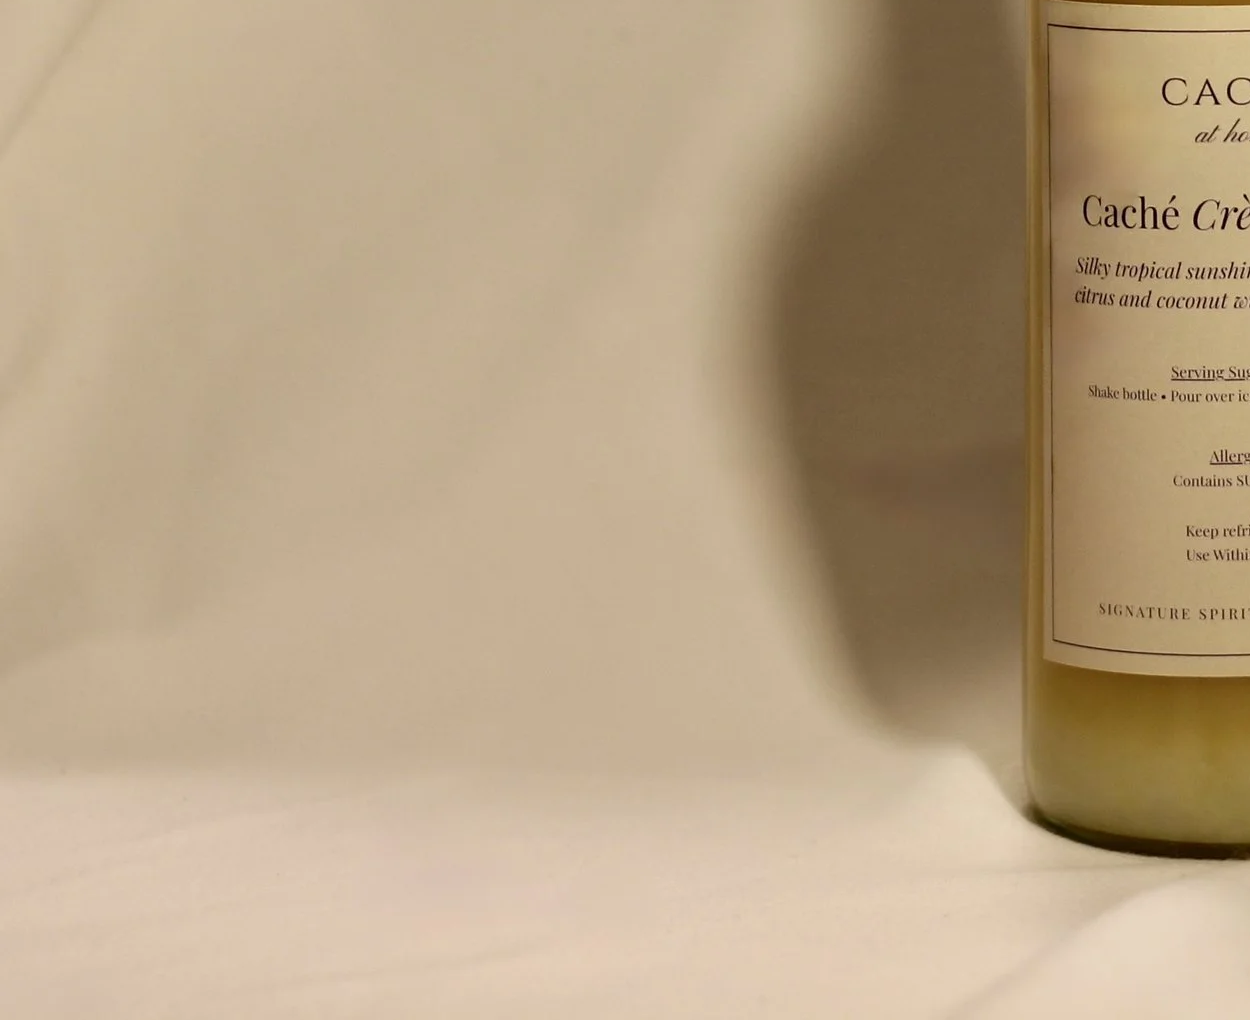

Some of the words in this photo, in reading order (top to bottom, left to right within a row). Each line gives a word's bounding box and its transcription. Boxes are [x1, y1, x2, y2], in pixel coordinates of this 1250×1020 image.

[1194, 124, 1221, 144] at
[1082, 194, 1180, 231] Caché
[1075, 256, 1112, 278] Silky
[1115, 260, 1181, 282] tropical
[1074, 285, 1116, 307] citrus
[1118, 289, 1153, 309] and
[1156, 291, 1229, 310] coconut
[1170, 364, 1225, 382] Serving
[1087, 383, 1120, 401] Shake
[1122, 388, 1158, 403] bottle
[1170, 389, 1202, 404] Pour
[1204, 391, 1236, 404] over
[1172, 473, 1233, 488] Contains
[1186, 525, 1219, 540] Keep
[1186, 549, 1210, 562] Use
[1098, 602, 1190, 621] SIGNATURE
